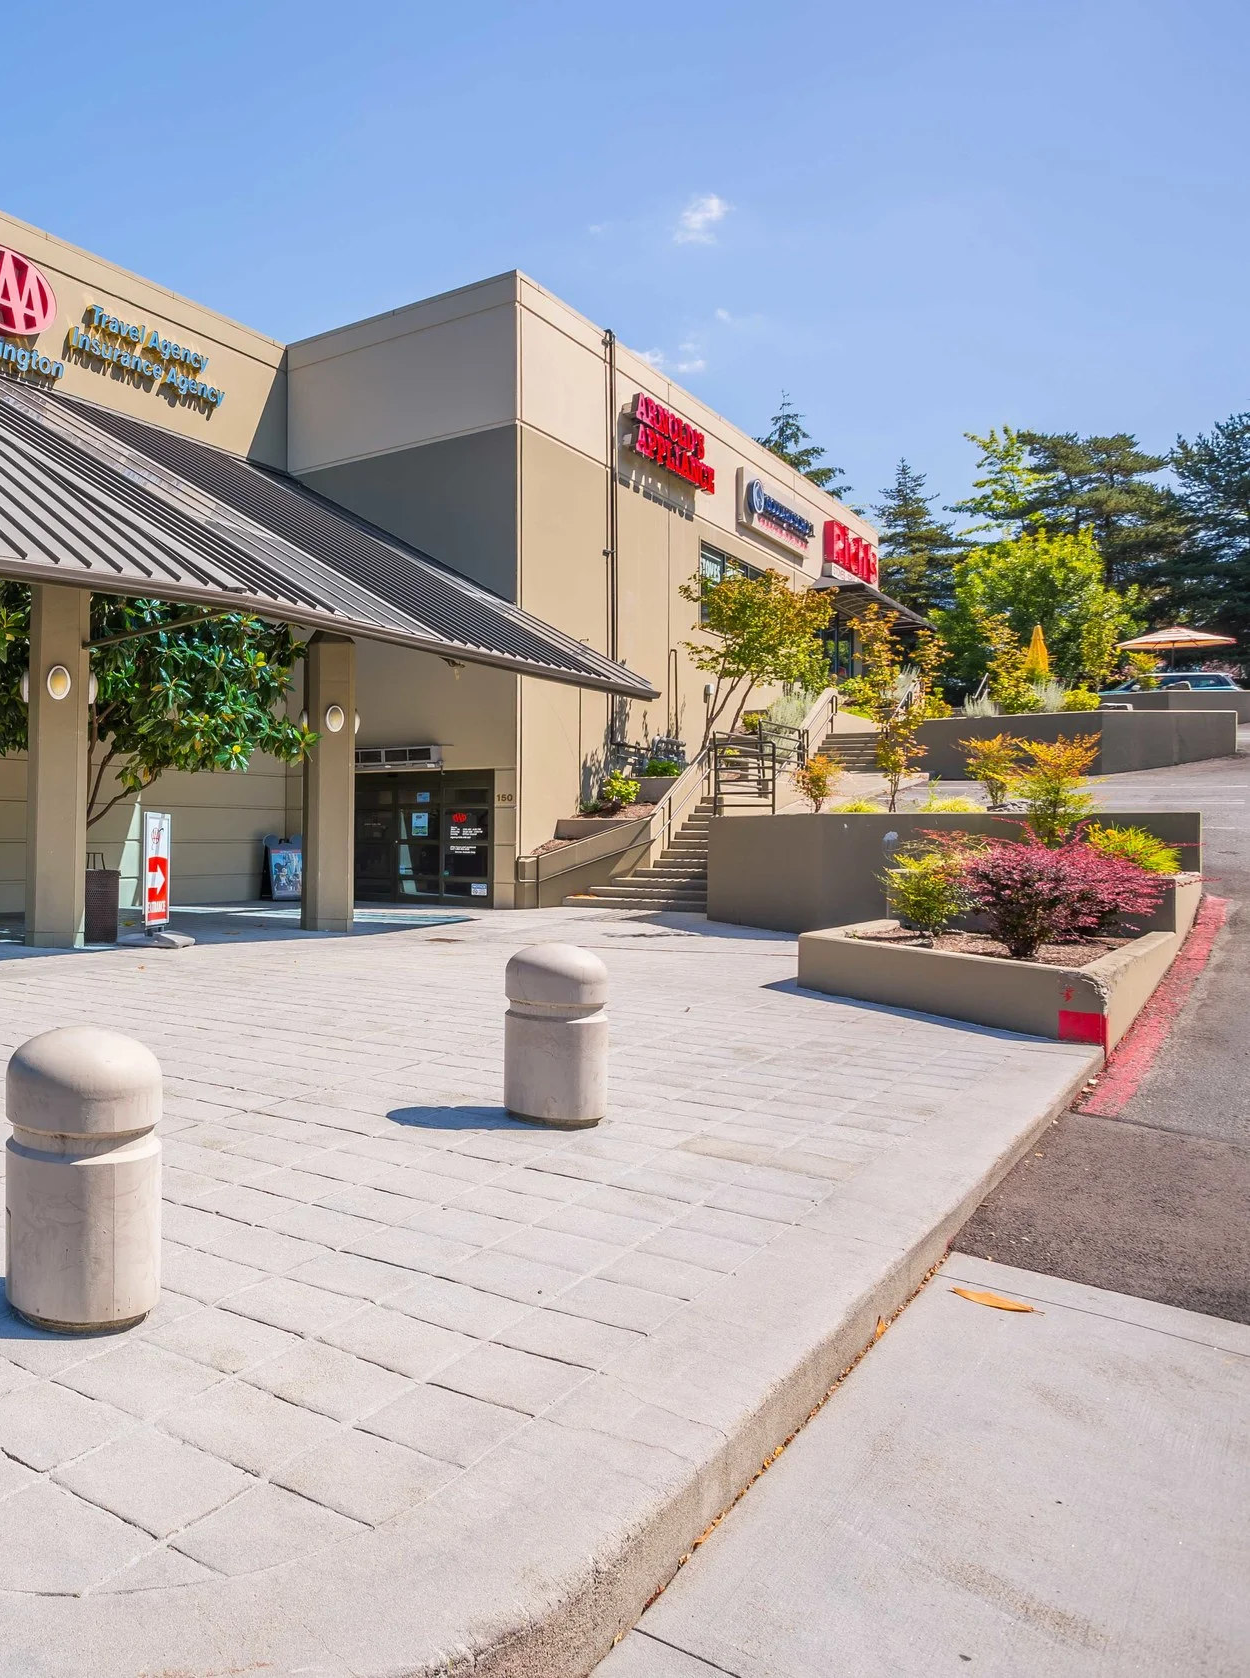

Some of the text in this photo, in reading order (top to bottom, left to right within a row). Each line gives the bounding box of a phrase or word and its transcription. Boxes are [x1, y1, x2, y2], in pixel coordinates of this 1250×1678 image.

[72, 326, 225, 408] Insurance Agency
[90, 304, 209, 373] Travel Agency
[636, 423, 714, 495] APPLIANCE
[497, 793, 513, 802] 150
